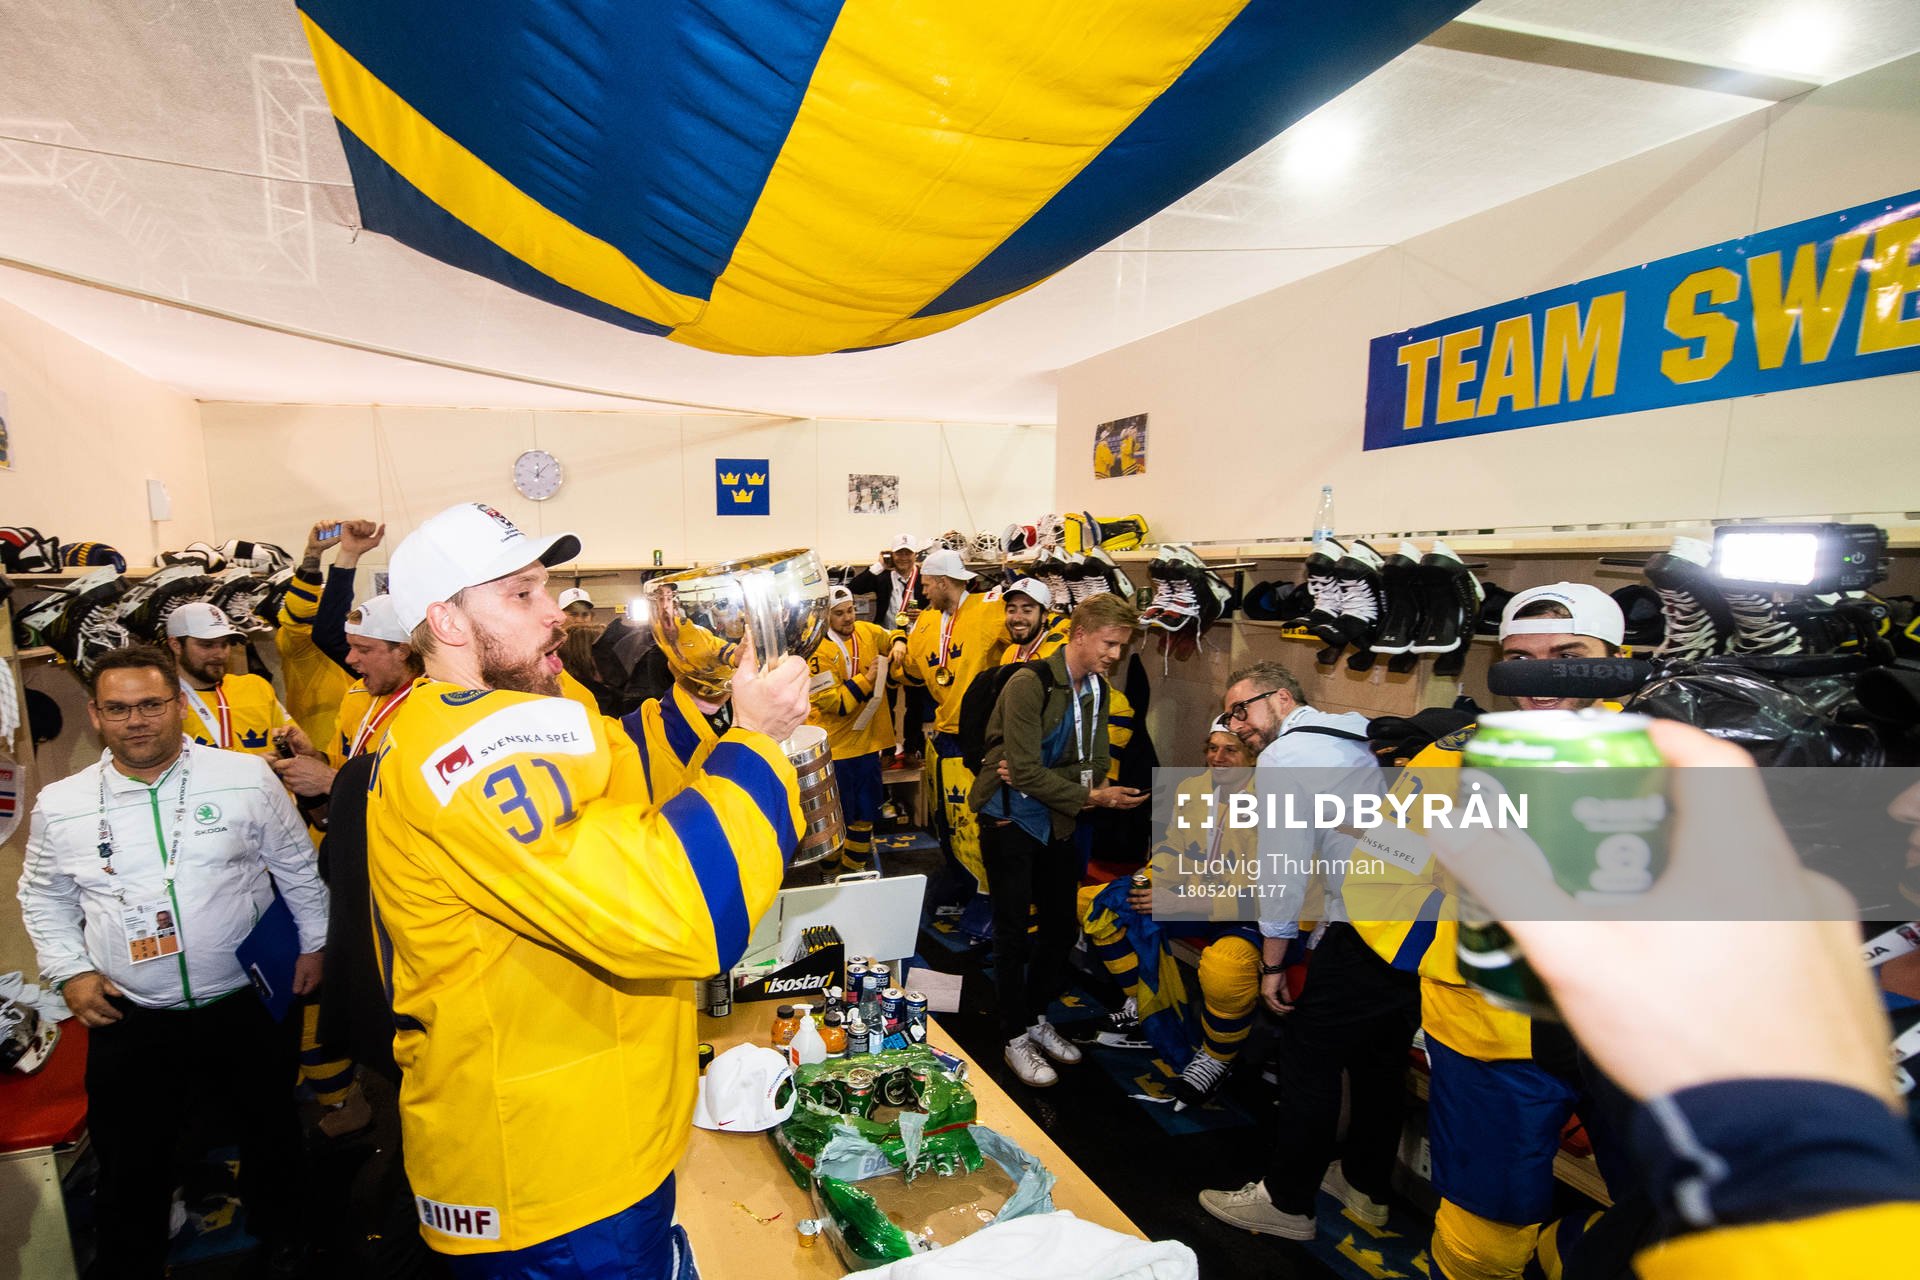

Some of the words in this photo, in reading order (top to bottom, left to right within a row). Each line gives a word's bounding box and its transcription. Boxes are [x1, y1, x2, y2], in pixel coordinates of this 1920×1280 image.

[1397, 290, 1627, 430] TEAM
[1660, 215, 1920, 385] SWE
[480, 734, 542, 757] SVENSKA
[546, 731, 579, 743] SPEL
[483, 758, 578, 844] 31
[1393, 849, 1416, 865] SPEL
[768, 974, 829, 993] isostar
[434, 1205, 491, 1235] IIHF
